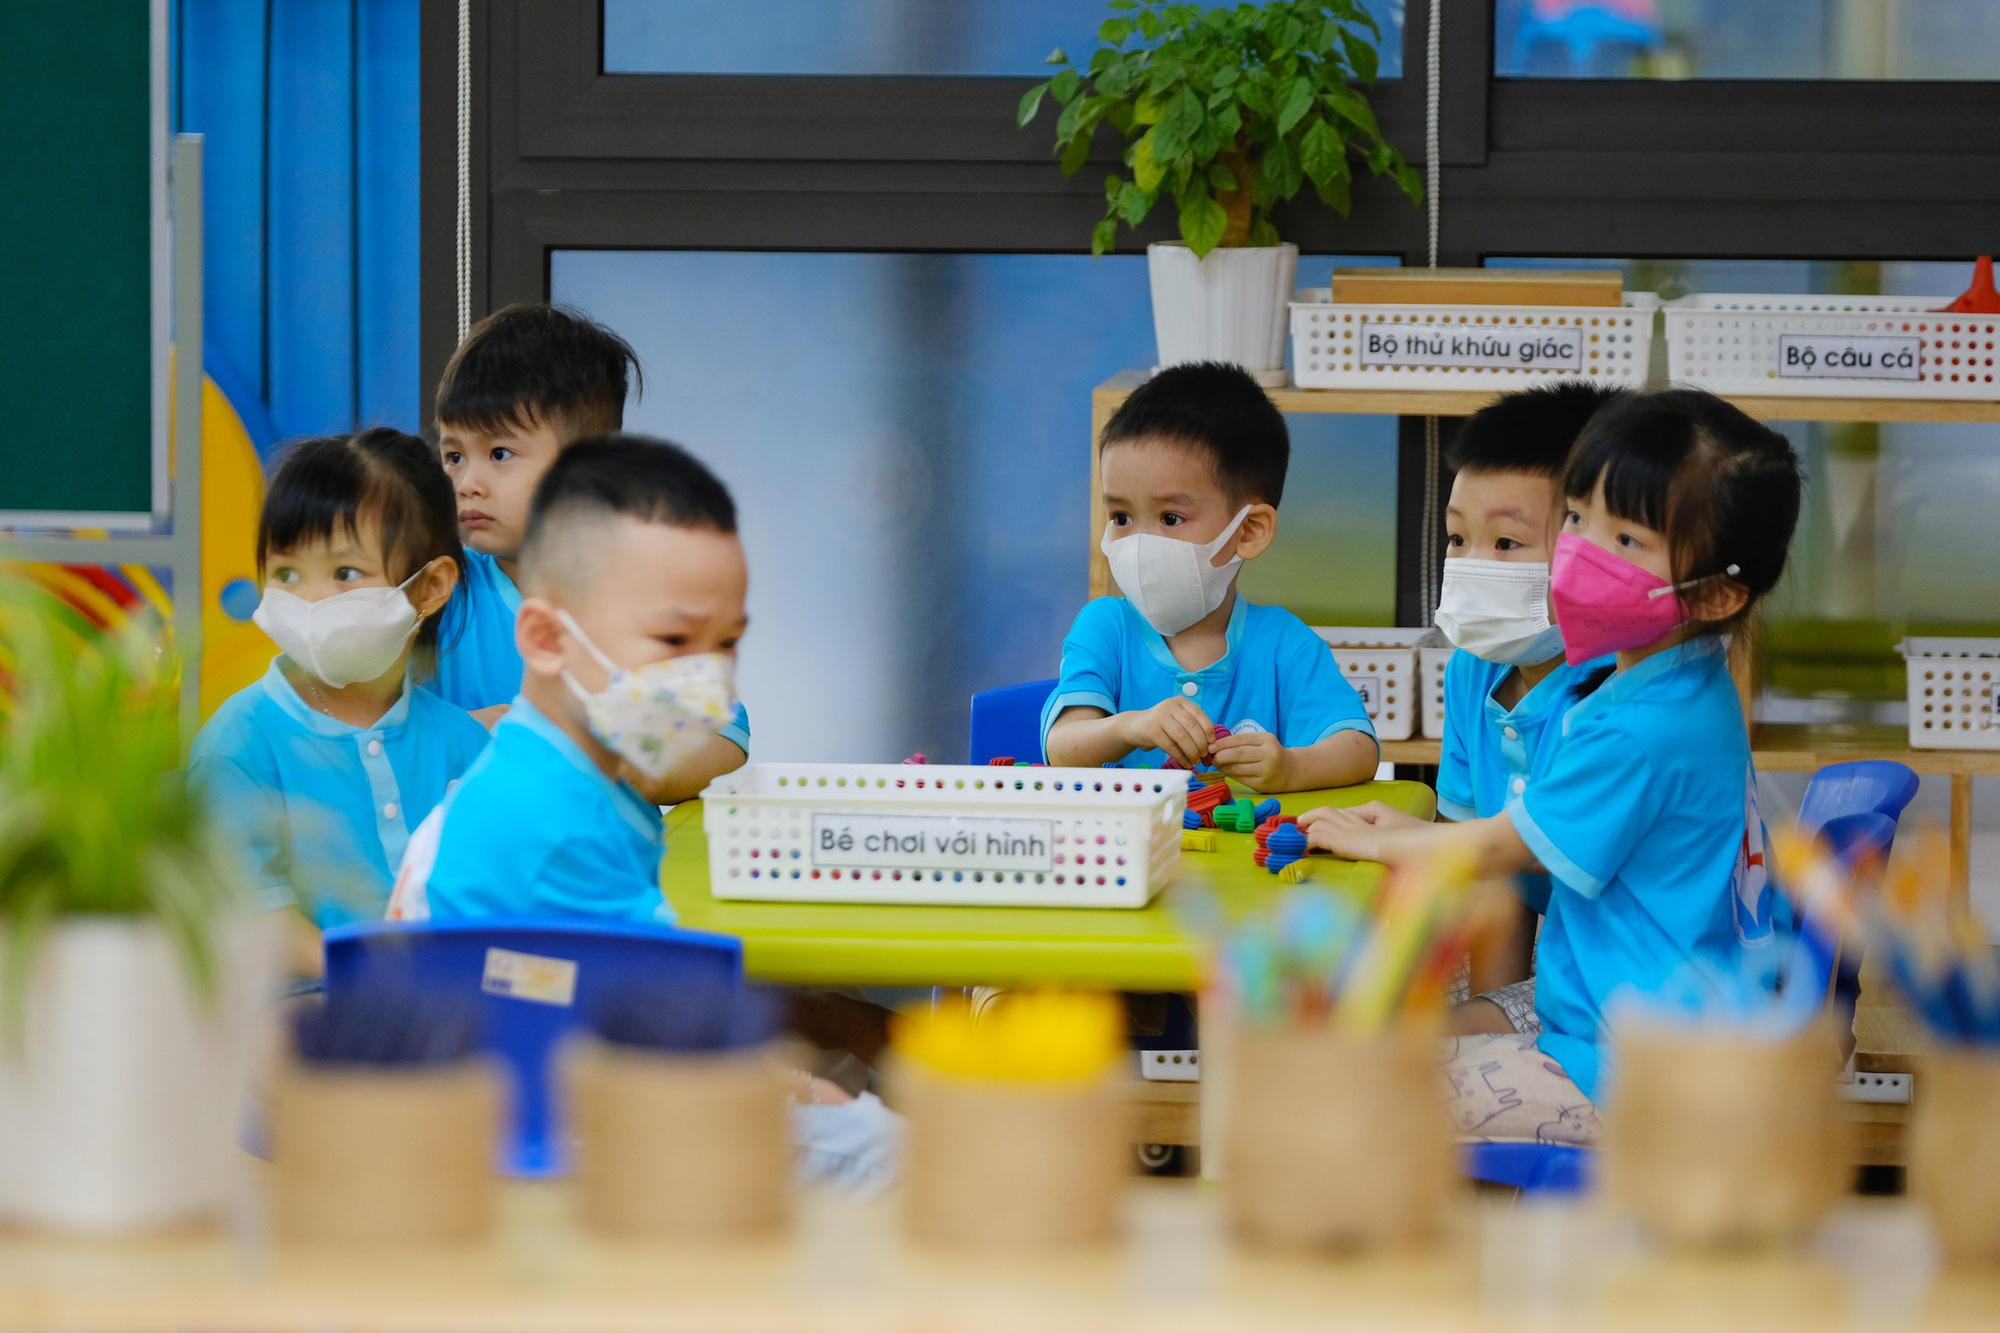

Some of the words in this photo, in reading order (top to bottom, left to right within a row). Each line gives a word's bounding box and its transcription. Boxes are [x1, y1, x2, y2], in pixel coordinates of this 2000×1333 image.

[1369, 333, 1398, 358] Bộ
[1451, 335, 1511, 357] khứu
[1518, 337, 1574, 363] giác
[1787, 345, 1817, 371] Bộ
[1824, 346, 1872, 367] câu
[1880, 346, 1913, 368] cá
[820, 827, 854, 850] Bé
[864, 830, 925, 853] chơi
[935, 830, 977, 855] với
[986, 831, 1045, 856] hình
